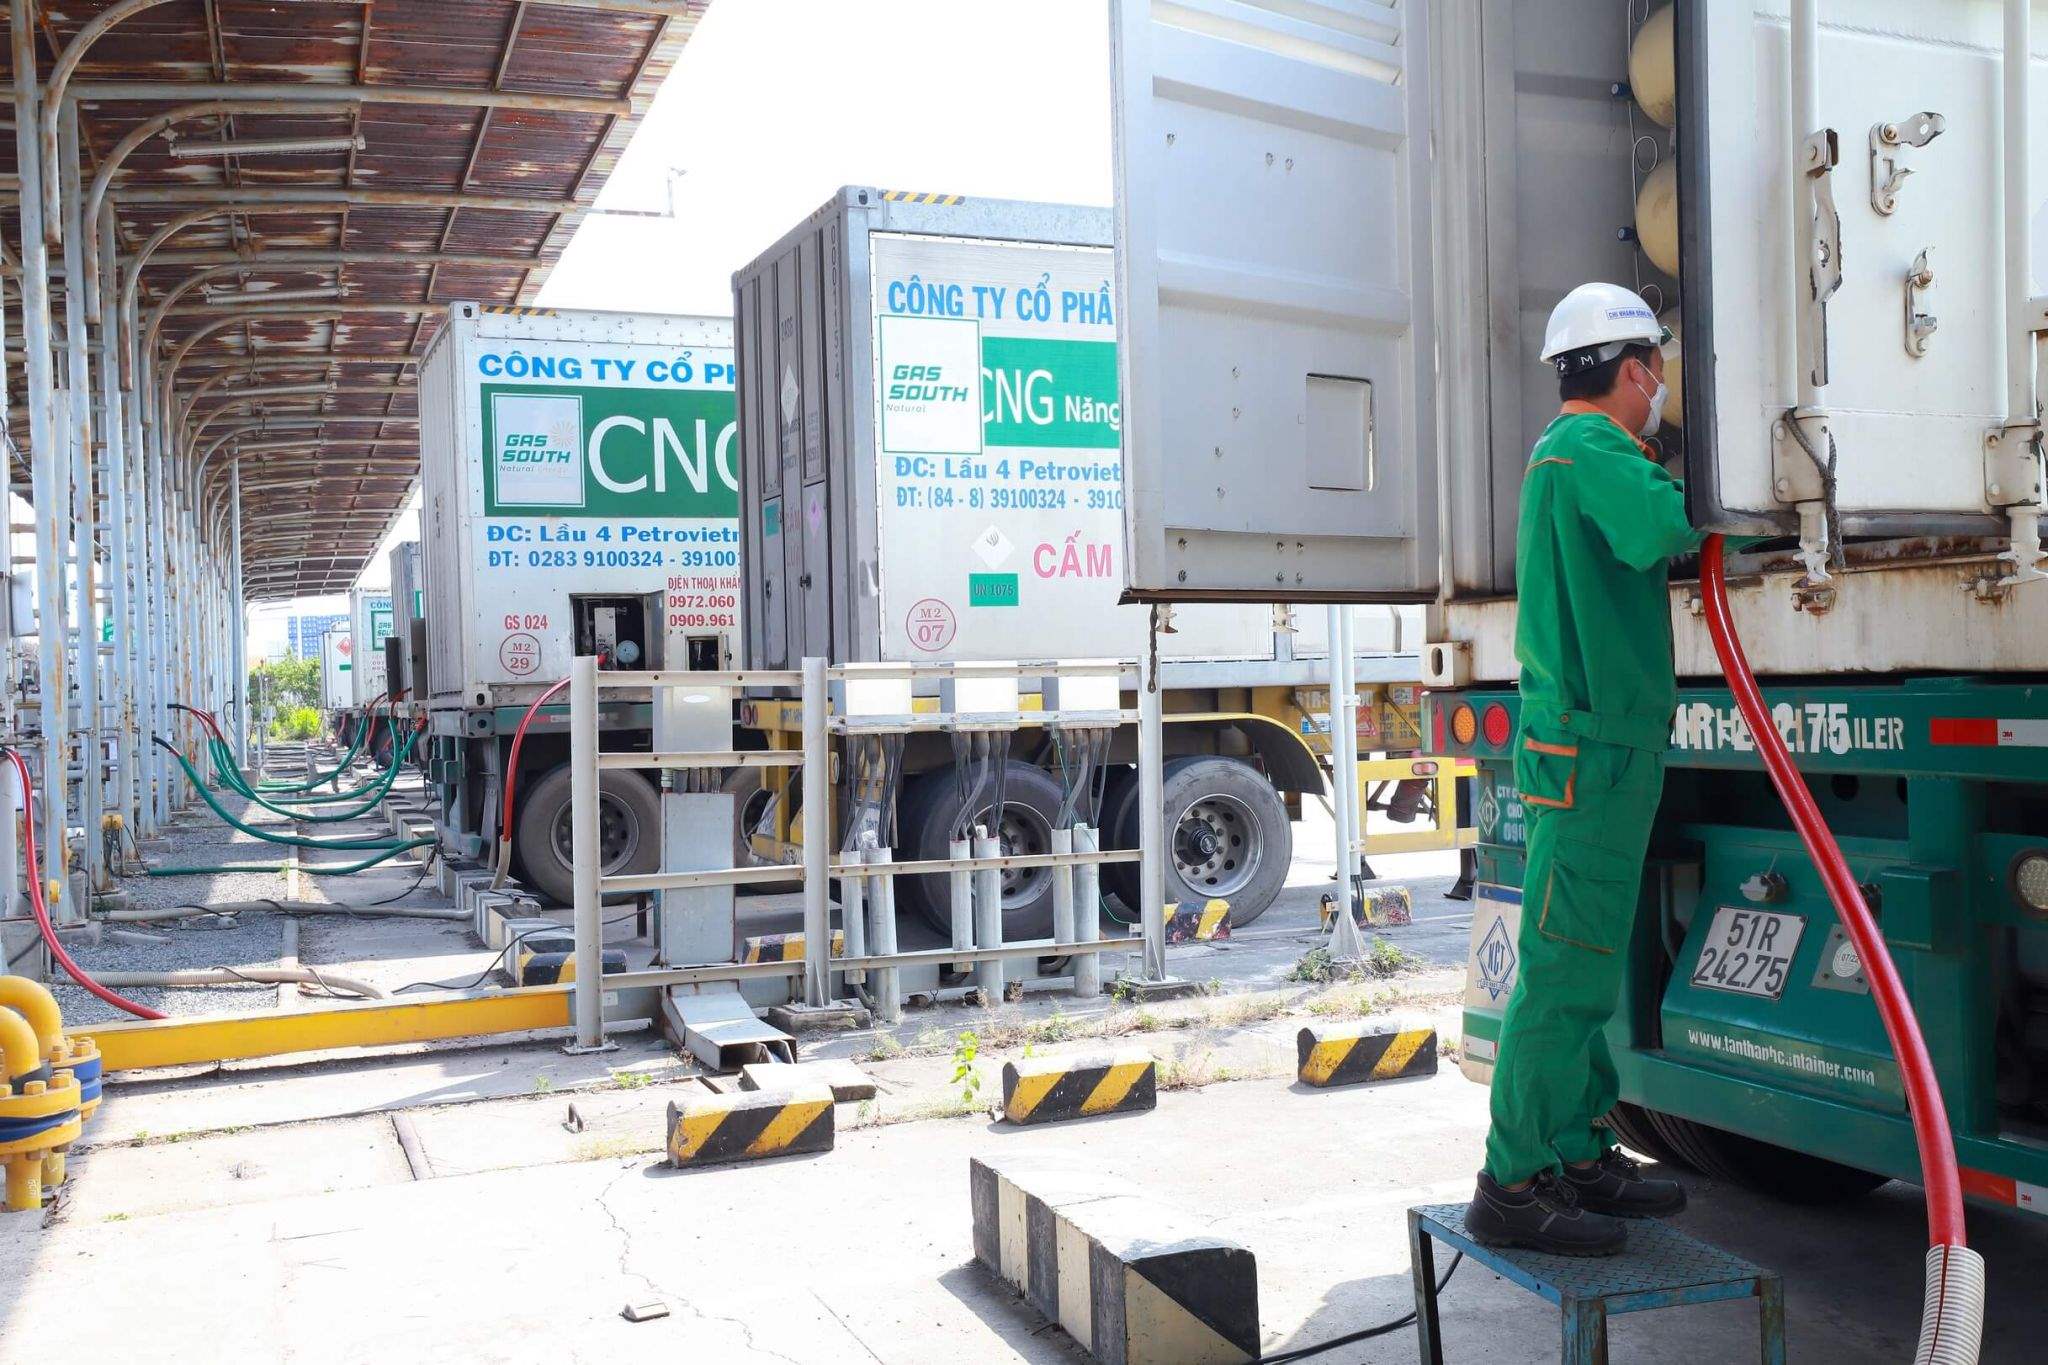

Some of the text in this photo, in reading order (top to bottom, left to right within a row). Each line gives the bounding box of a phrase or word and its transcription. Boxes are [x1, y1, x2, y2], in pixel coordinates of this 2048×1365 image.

[888, 275, 964, 317] CÔNG
[972, 286, 1006, 320] TY
[1016, 272, 1051, 322] CỔ
[478, 350, 582, 378] CÔNG
[591, 359, 636, 381] TY
[646, 350, 693, 383] CỔ
[893, 365, 942, 381] GAS
[888, 384, 968, 402] SOUTH
[886, 403, 927, 413] Natural
[1065, 395, 1120, 429] Năng
[505, 434, 548, 447] GAS
[502, 449, 571, 463] SOUTH
[499, 464, 534, 473] Natural
[895, 456, 936, 478] ĐC:
[944, 457, 987, 480] Lầu
[996, 459, 1010, 479] 4
[896, 486, 923, 507] ĐT:
[928, 487, 953, 508] (84
[969, 488, 984, 509] 8)
[990, 488, 1066, 509] 39100324
[486, 525, 531, 542] ĐC:
[540, 523, 586, 542] Lầu
[595, 526, 611, 541] 4
[488, 550, 520, 567] ĐT:
[528, 551, 577, 567] 0283
[584, 551, 663, 567] 9100324
[682, 550, 741, 567] 39100
[1033, 529, 1112, 579] CẤM
[691, 576, 718, 591] THOẠI
[991, 584, 1014, 596] 1075
[669, 595, 736, 608] 0972.060
[669, 614, 736, 627] 0909.961
[920, 608, 941, 619] M2
[504, 614, 549, 630] GS 024
[918, 625, 945, 643] 07
[513, 642, 531, 651] M2
[510, 657, 530, 669] 29
[1727, 912, 1781, 952] 51R
[1692, 946, 1789, 993] 242.75
